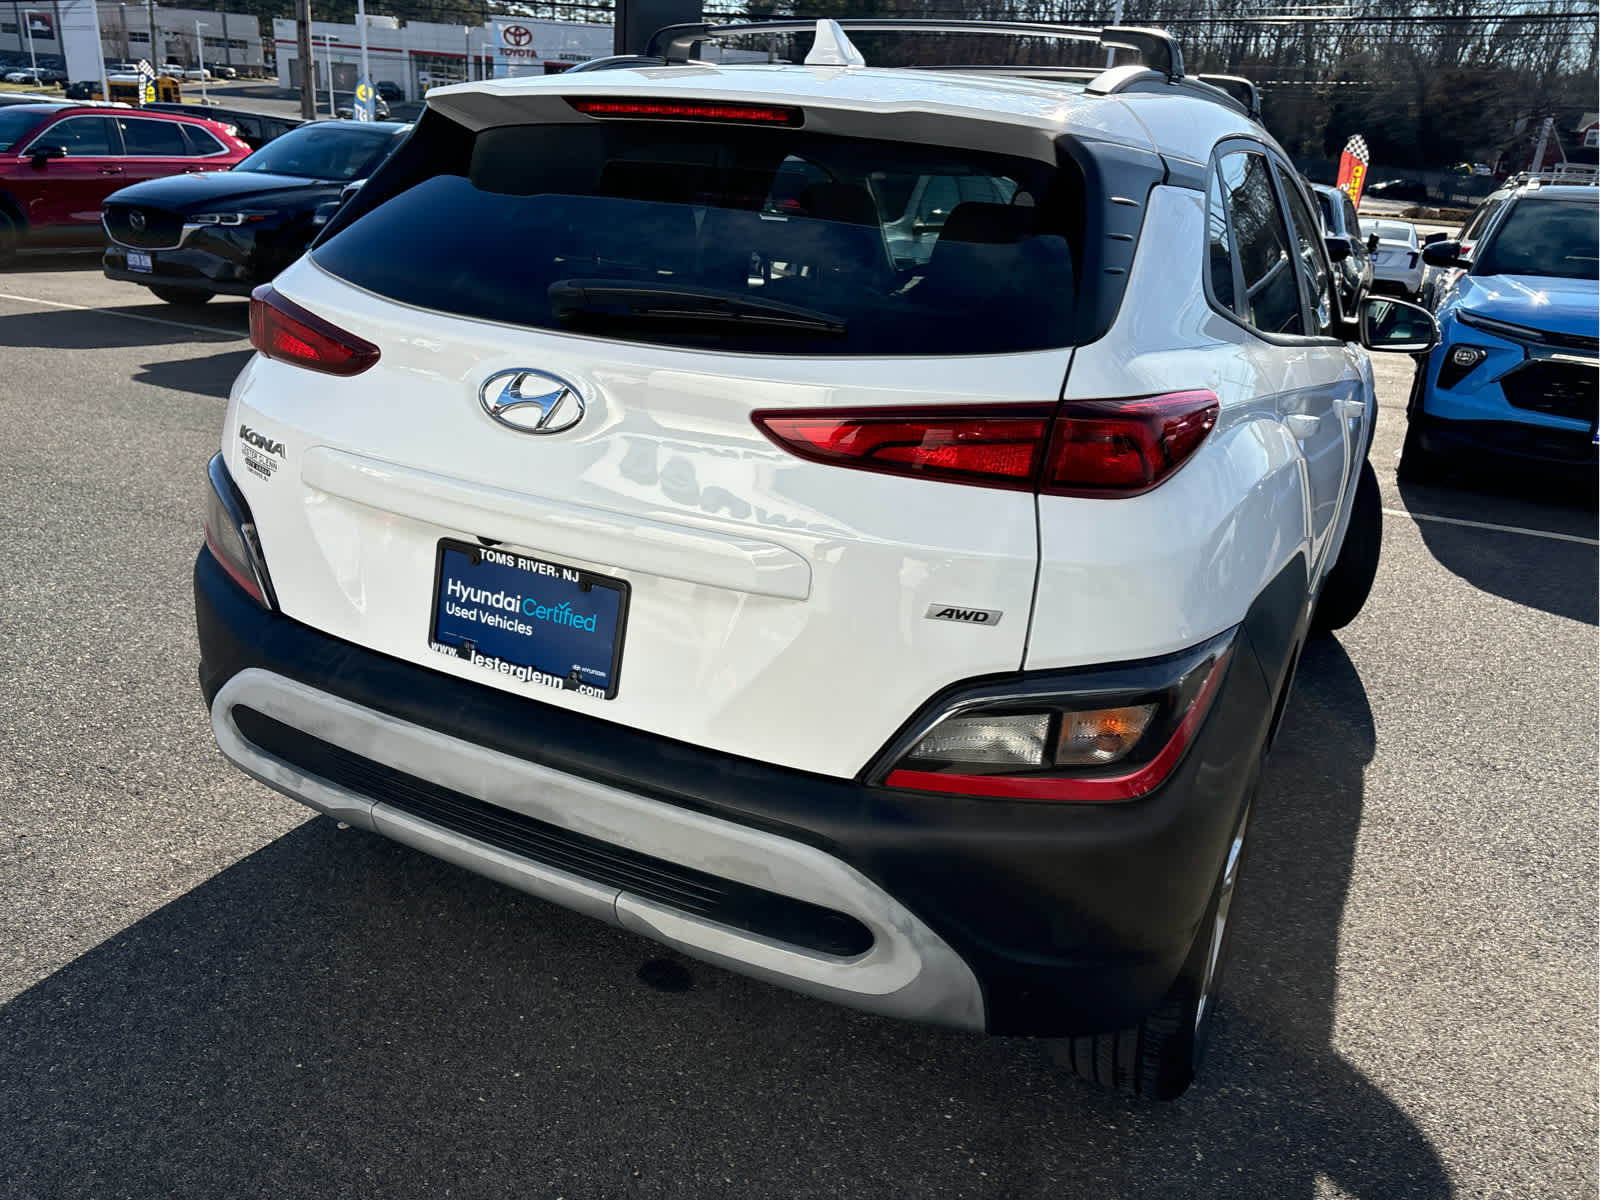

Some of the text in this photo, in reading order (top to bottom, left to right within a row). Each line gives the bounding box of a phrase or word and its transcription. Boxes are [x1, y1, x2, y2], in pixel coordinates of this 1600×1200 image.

[499, 47, 538, 58] TOYOTA
[239, 424, 287, 459] KONA
[479, 548, 580, 583] TOMS RIVER, NJ
[445, 601, 534, 636] Used Vehicles
[447, 578, 597, 633] Hyundai Certified
[936, 608, 988, 622] AWD
[431, 641, 606, 700] www. lesterglenn .com
